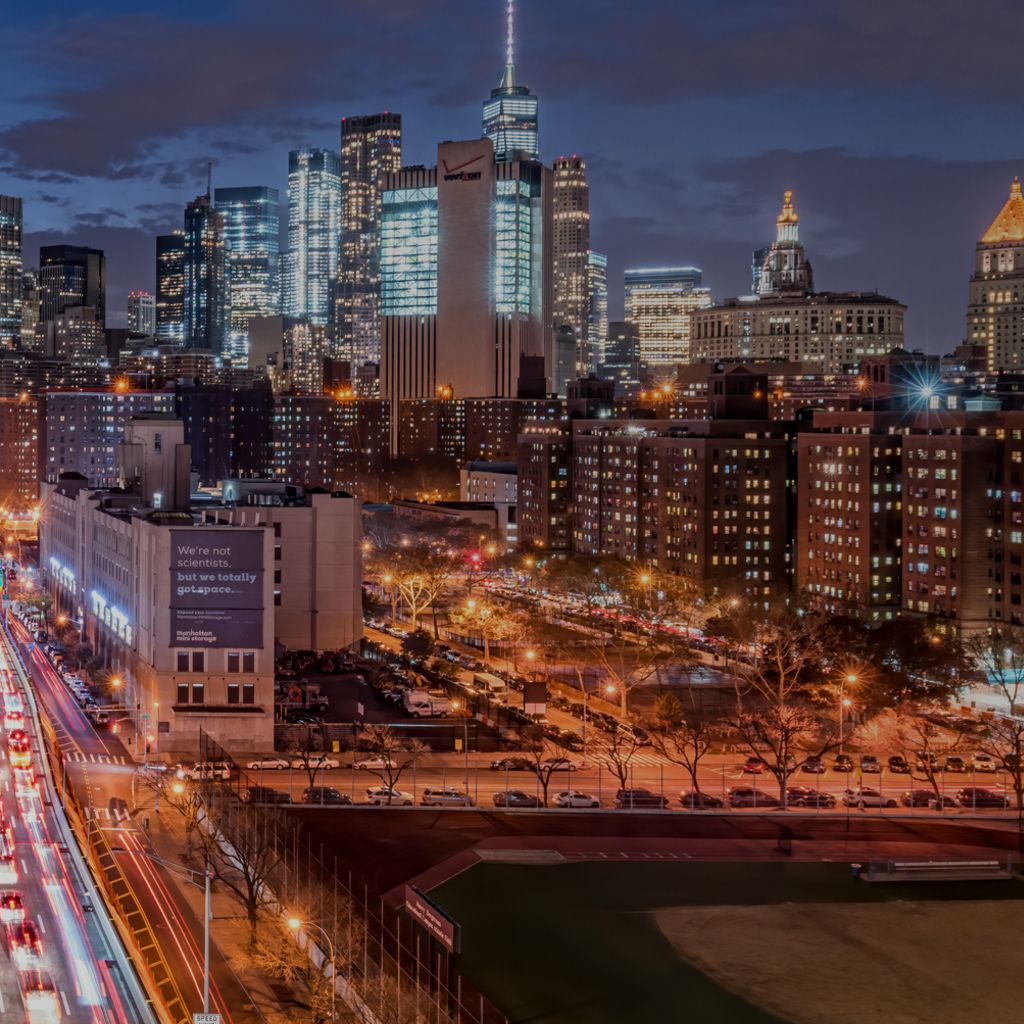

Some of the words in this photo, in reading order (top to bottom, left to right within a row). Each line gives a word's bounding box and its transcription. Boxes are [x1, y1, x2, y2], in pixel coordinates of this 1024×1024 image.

[177, 545, 210, 556] We're
[212, 546, 231, 556] not
[177, 557, 232, 568] scientists.
[177, 572, 197, 581] but
[199, 573, 216, 581] we
[217, 572, 257, 584] totally
[177, 585, 195, 596] got
[197, 585, 234, 596] space.
[176, 629, 213, 637] manhattan
